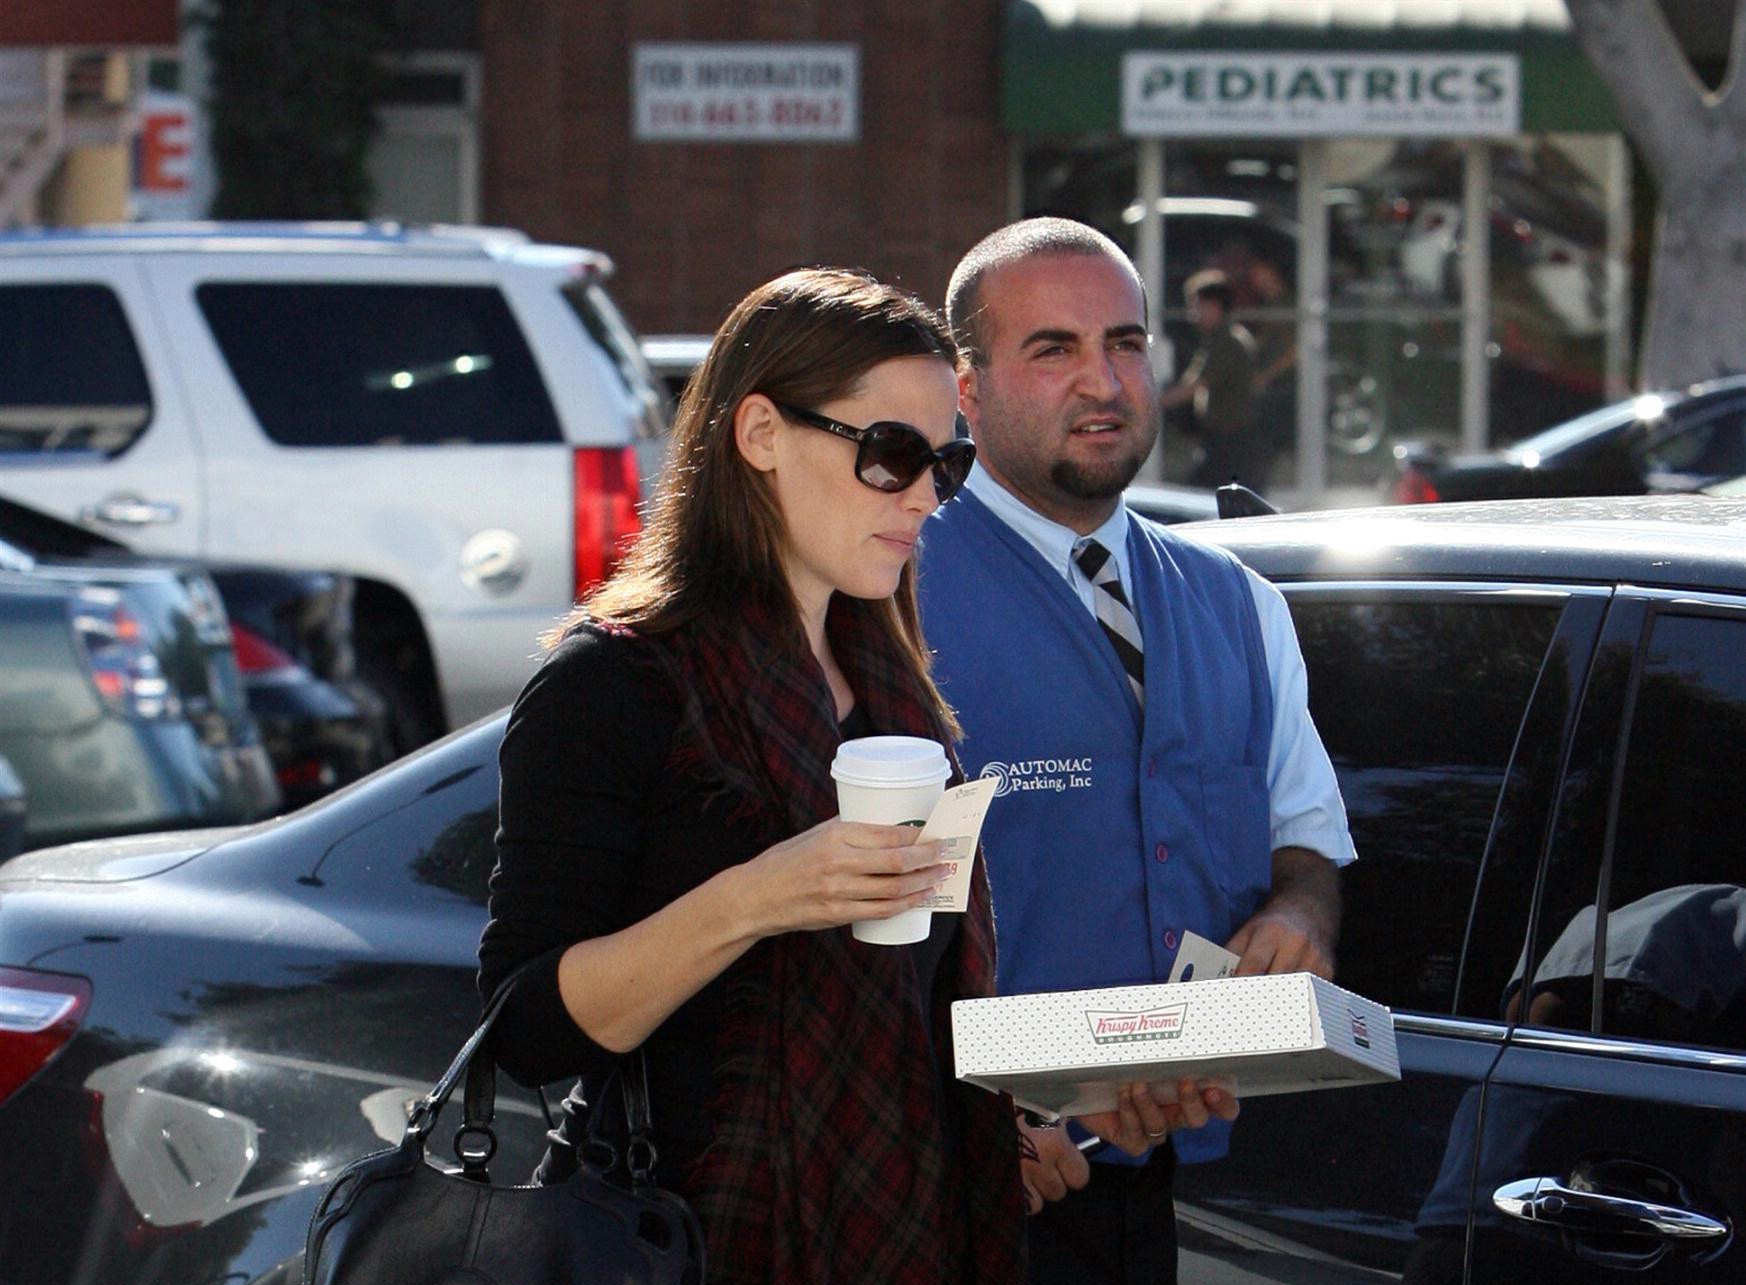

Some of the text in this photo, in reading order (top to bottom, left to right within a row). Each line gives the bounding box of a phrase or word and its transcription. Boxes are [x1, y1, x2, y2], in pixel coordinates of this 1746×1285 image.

[1141, 66, 1503, 101] PEDIATRICS
[1008, 758, 1092, 776] AUTOMAC
[1012, 775, 1092, 792] Parking, Inc
[1096, 1014, 1179, 1034] Krispy Kreme
